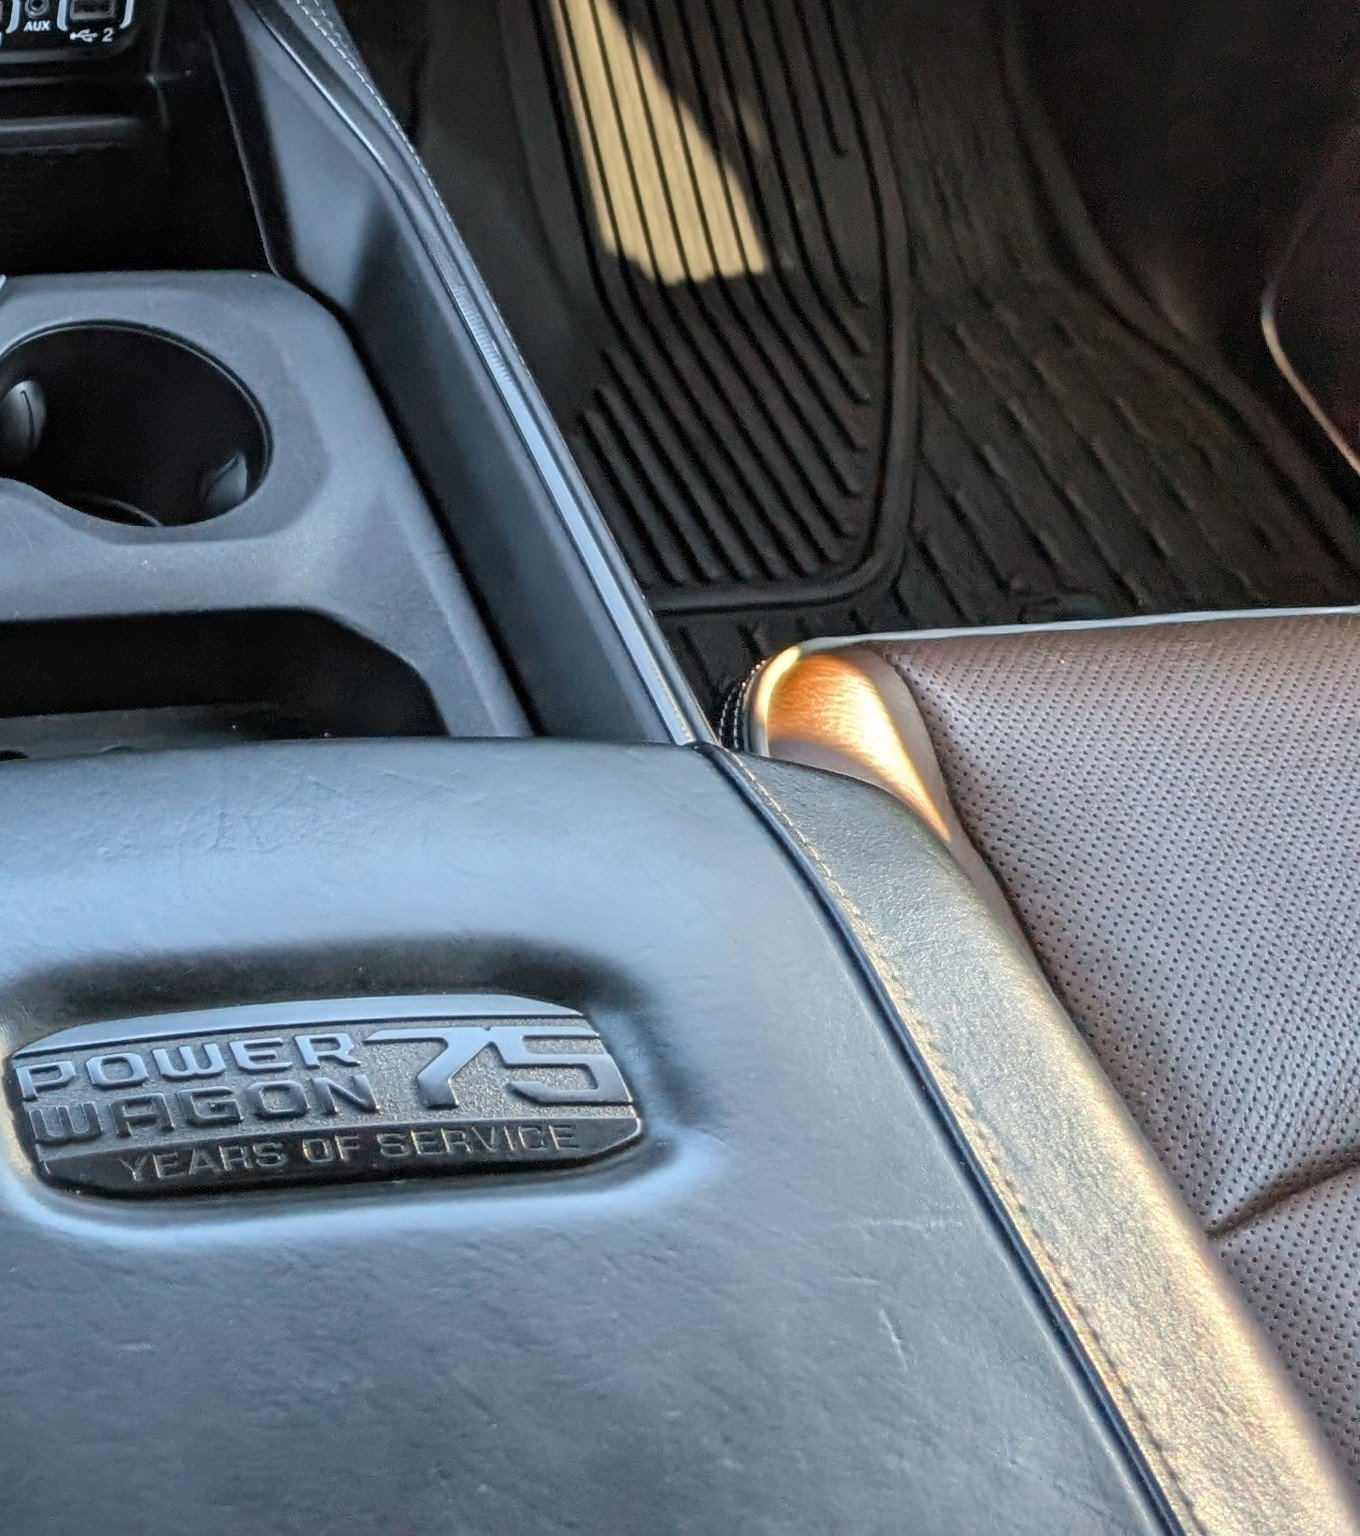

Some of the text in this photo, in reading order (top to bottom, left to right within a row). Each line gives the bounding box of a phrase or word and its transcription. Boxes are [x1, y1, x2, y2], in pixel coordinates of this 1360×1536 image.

[23, 20, 50, 32] AUX
[101, 27, 115, 42] 2
[15, 1031, 361, 1102] POWER
[361, 1025, 634, 1110] 75
[28, 1072, 381, 1145] WAGON
[119, 1122, 581, 1183] YEARS OF SERVICE
